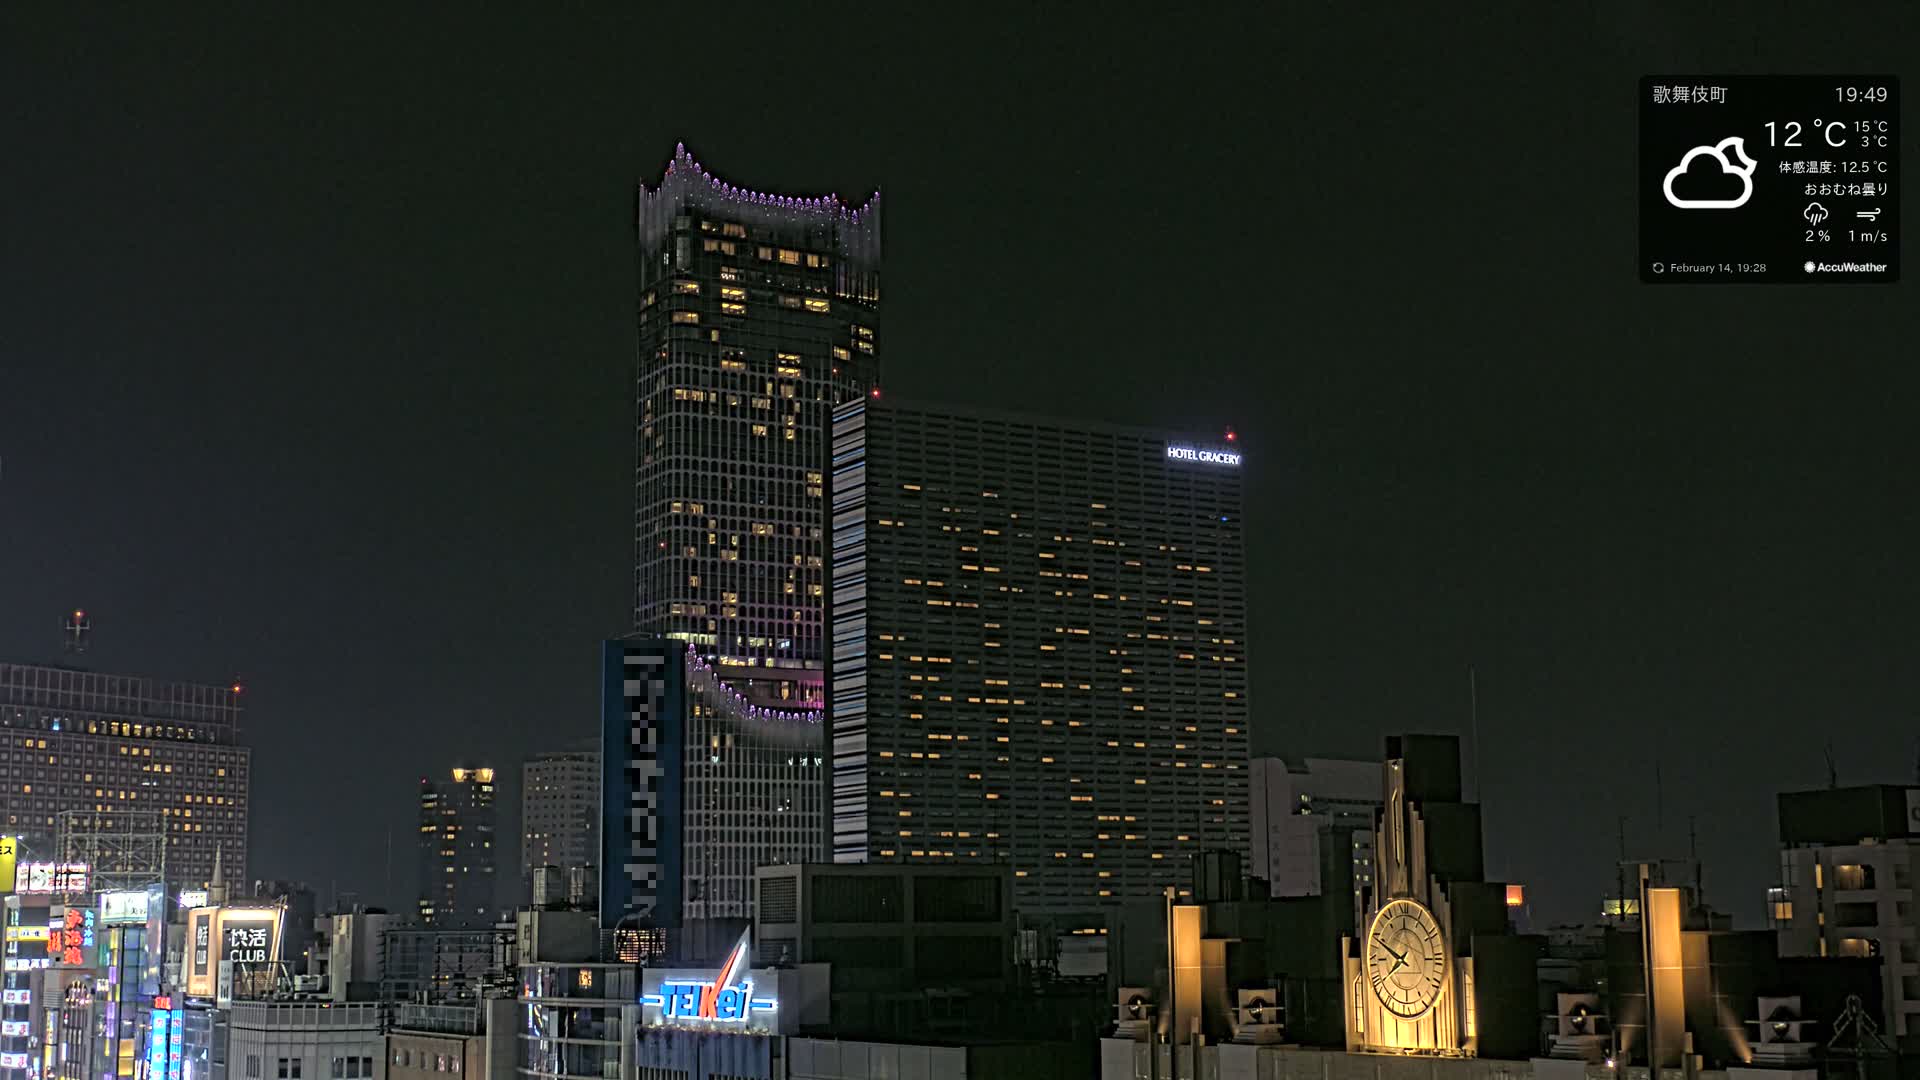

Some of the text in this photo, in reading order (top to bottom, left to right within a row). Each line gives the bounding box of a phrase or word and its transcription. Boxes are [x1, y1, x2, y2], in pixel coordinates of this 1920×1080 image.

[1167, 446, 1241, 465] HOTEL GRACERY
[230, 928, 267, 948] 快活
[230, 949, 266, 963] CLUB
